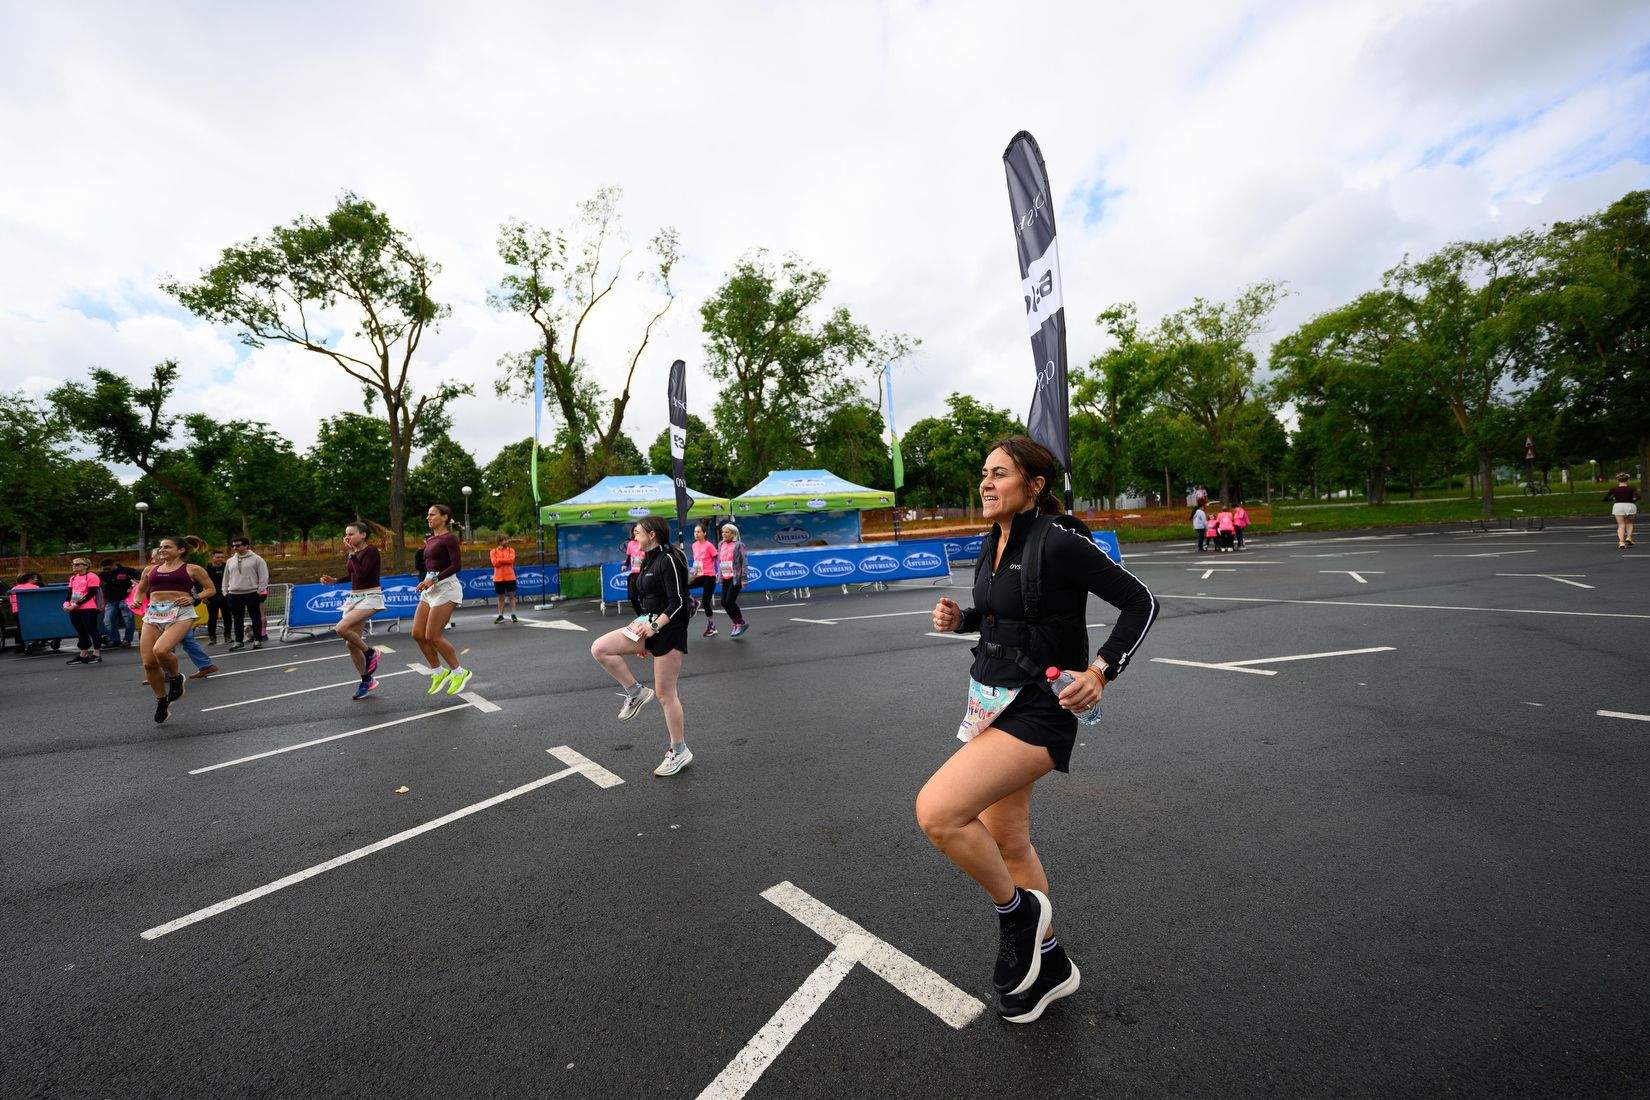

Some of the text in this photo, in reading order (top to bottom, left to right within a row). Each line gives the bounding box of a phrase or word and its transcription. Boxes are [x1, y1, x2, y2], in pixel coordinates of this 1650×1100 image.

[863, 561, 897, 571] ASTURIANA
[906, 558, 939, 567] ASTURIANA
[769, 568, 806, 578] ASTURIANA
[817, 565, 852, 574] ASTURIANA
